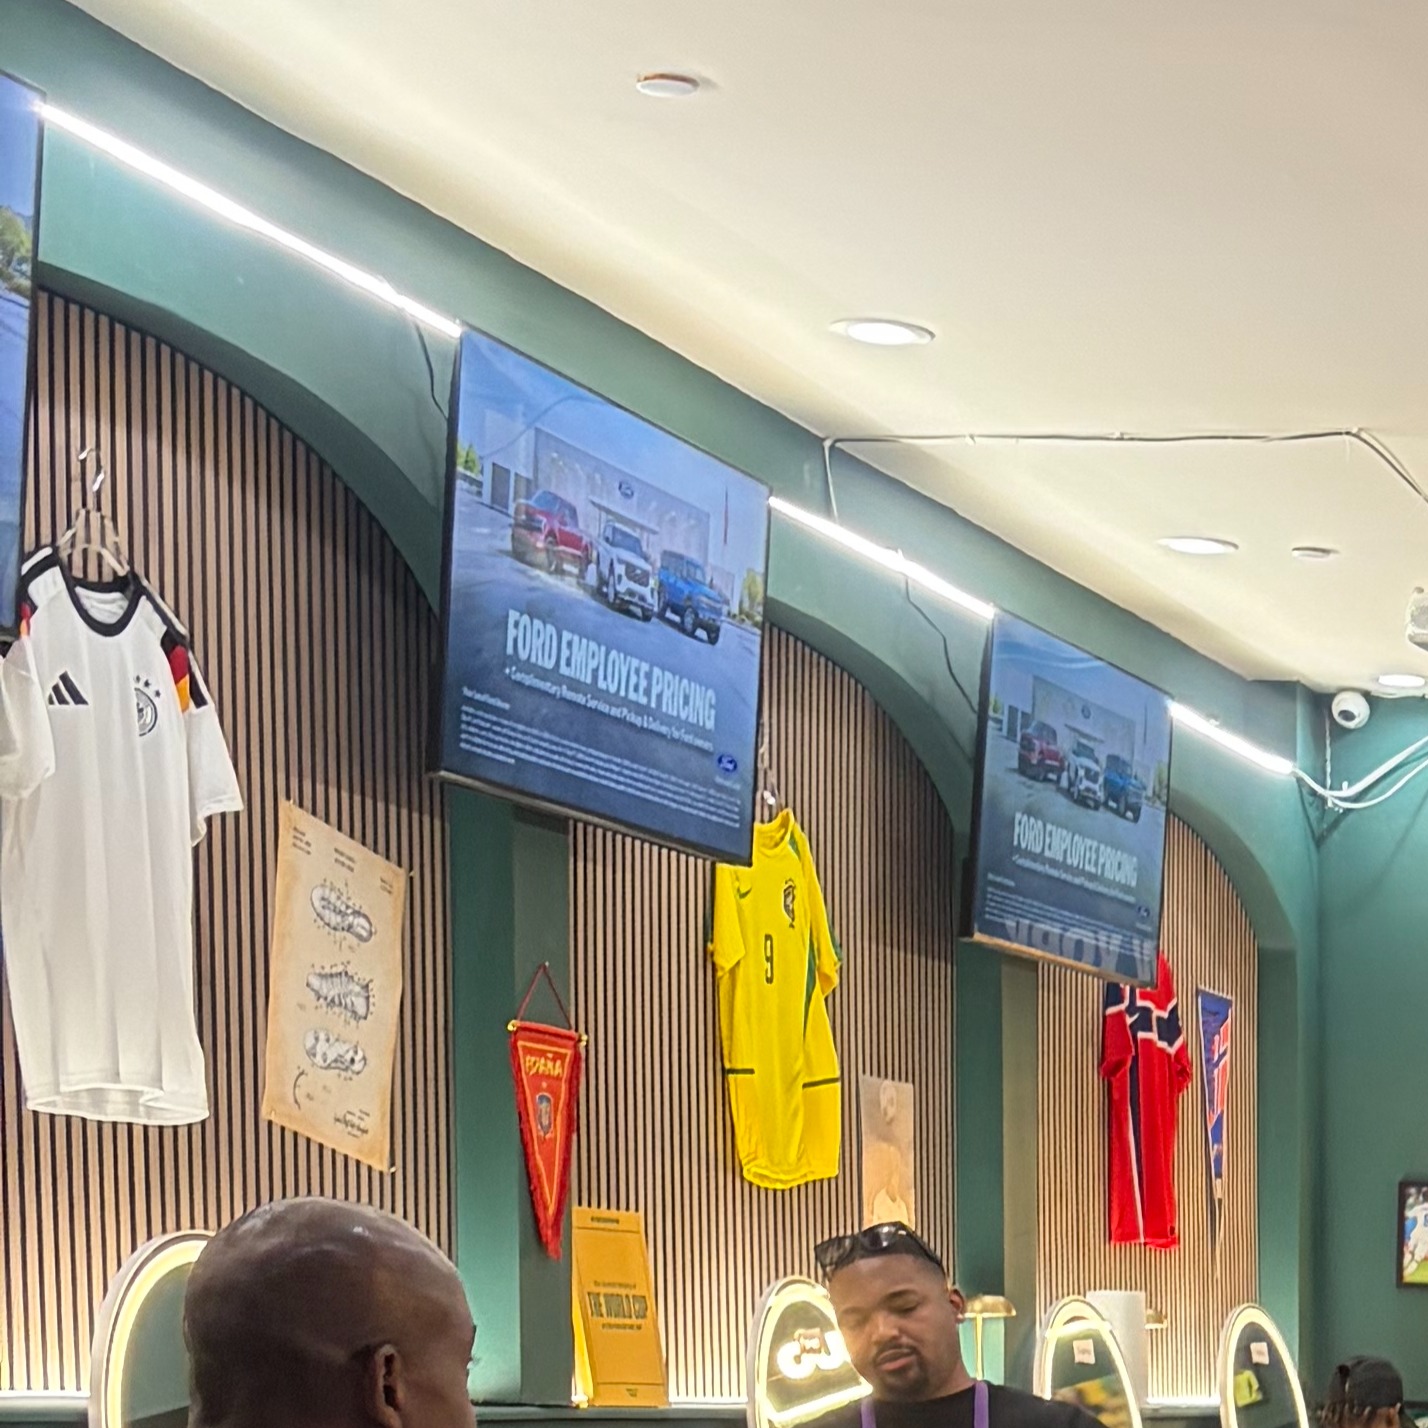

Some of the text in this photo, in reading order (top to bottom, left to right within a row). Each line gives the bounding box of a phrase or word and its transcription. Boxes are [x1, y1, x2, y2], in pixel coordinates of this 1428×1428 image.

[506, 609, 716, 731] FORD EMPLOYEE PRICING
[1013, 812, 1043, 853] FORD
[1044, 823, 1097, 873] EMPLOYEE
[1098, 841, 1138, 888] PRICING
[764, 934, 774, 985] 9
[603, 1293, 632, 1319] WORLD
